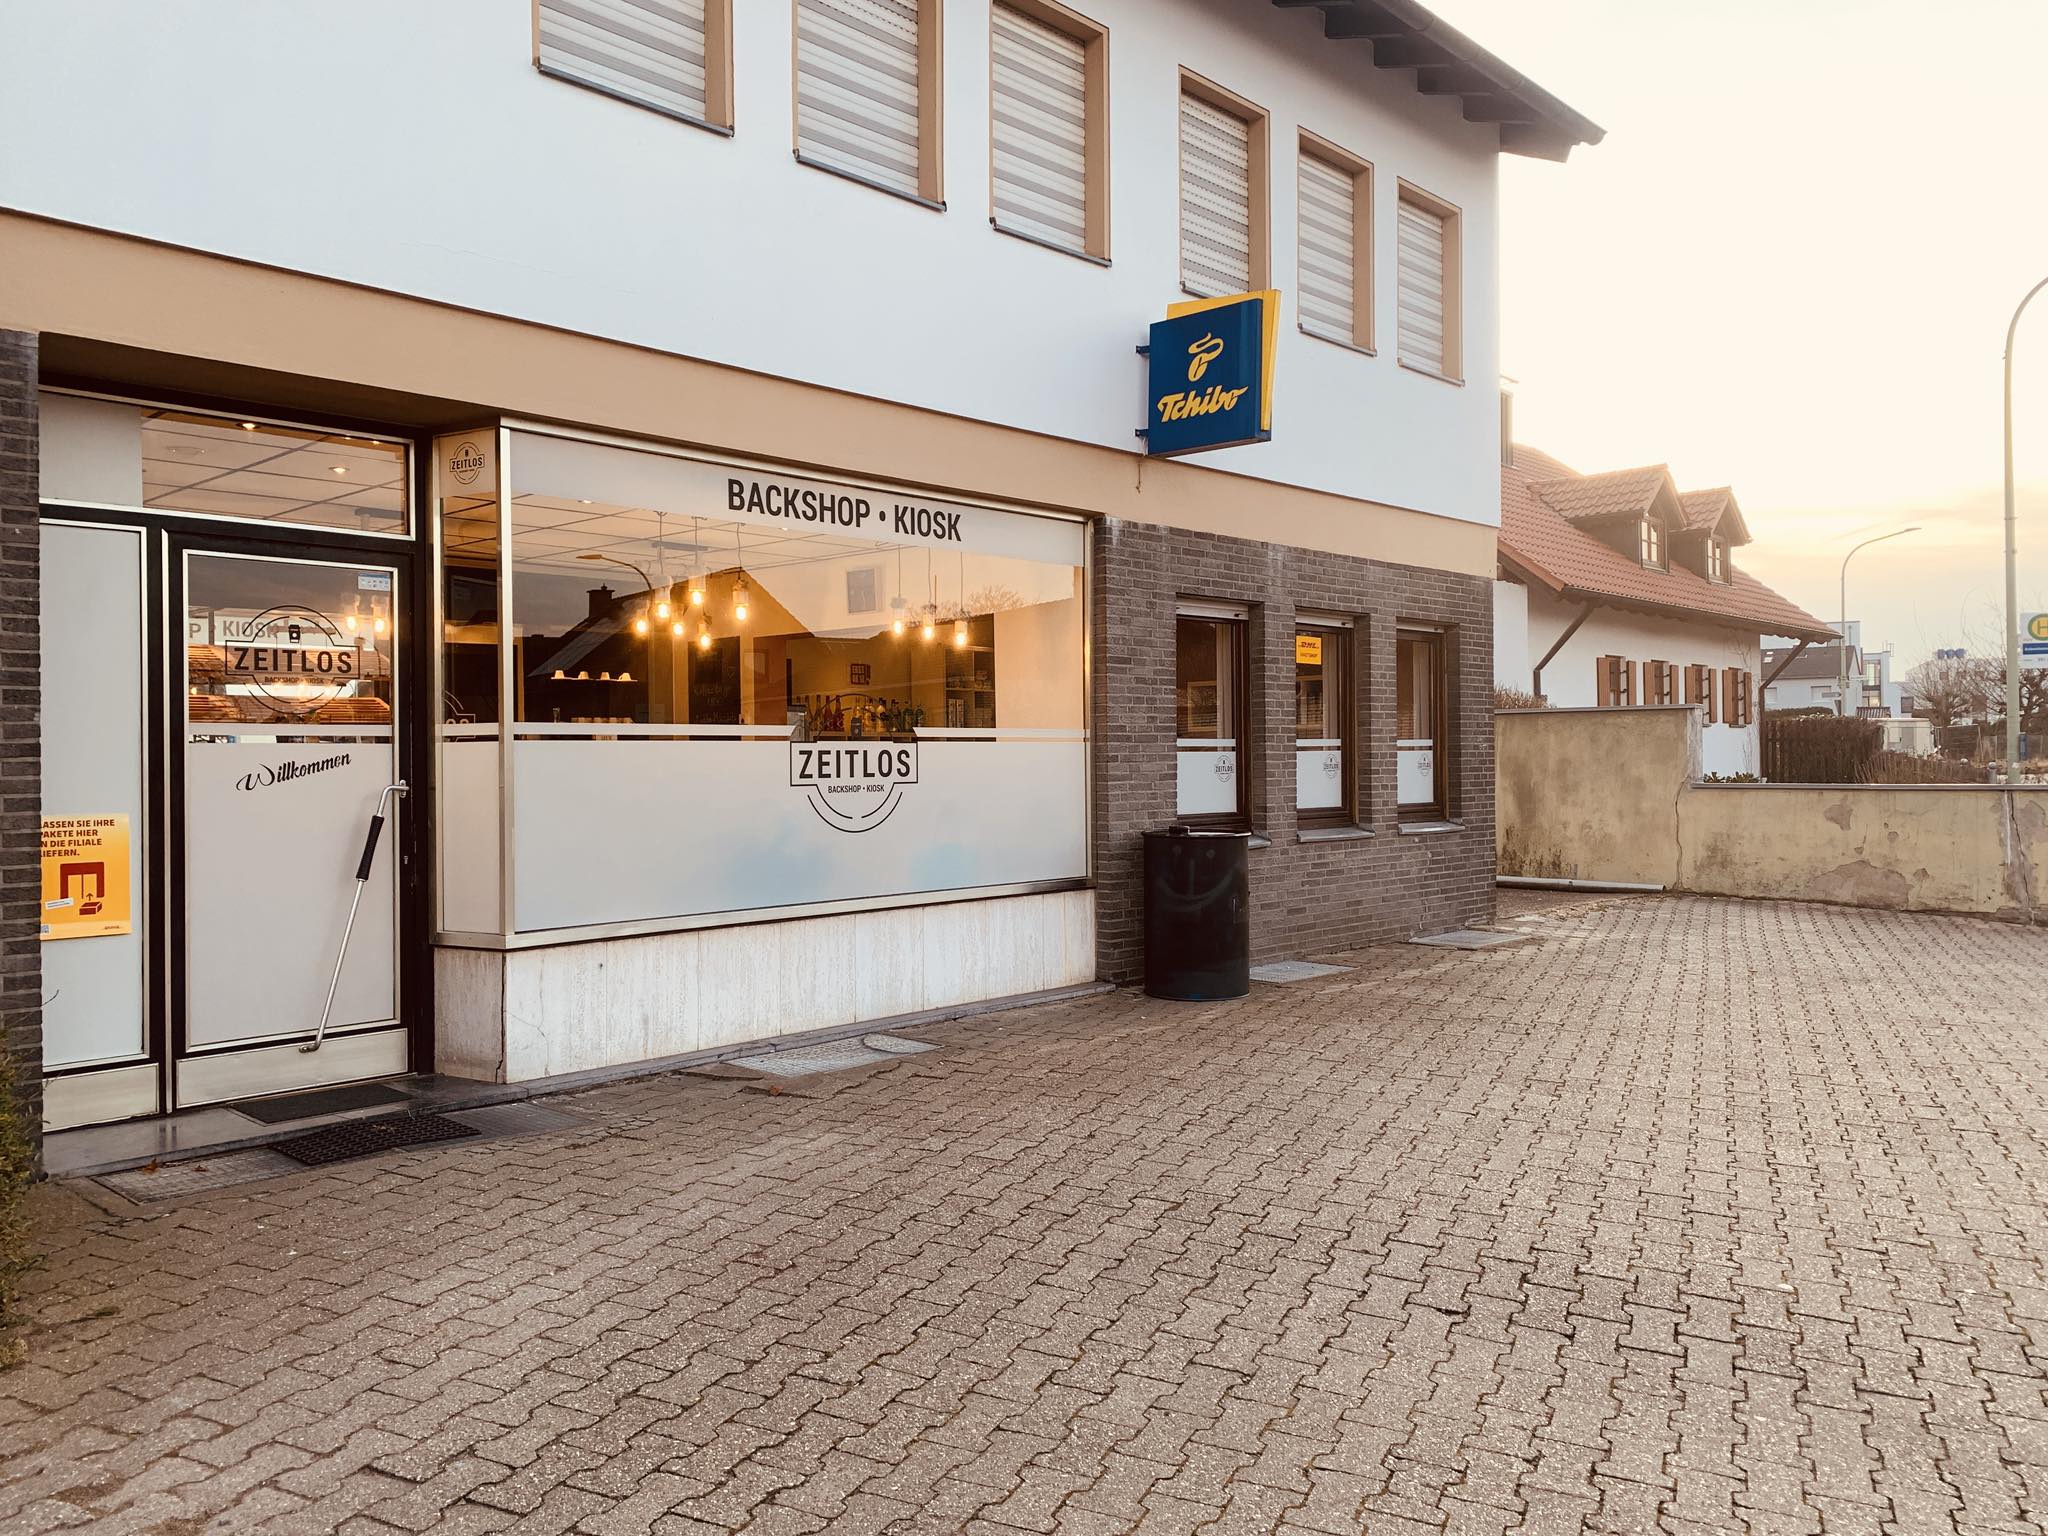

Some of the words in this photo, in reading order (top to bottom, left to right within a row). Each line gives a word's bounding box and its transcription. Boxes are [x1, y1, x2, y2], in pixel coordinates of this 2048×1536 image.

[1157, 385, 1248, 423] Tchibo
[451, 457, 483, 470] ZEITLOS
[727, 478, 871, 528] BACKSHOP
[894, 504, 962, 542] KIOSK
[233, 647, 352, 674] ZEITLOS
[264, 676, 300, 684] BACKSHOP
[798, 749, 911, 779] ZEITLOS
[236, 753, 352, 791] Willkommen
[828, 785, 862, 794] BACKSHOP
[866, 784, 885, 793] KIOSK
[41, 820, 74, 829] ASSEN
[93, 819, 115, 827] IHRE
[76, 829, 98, 837] HIER
[68, 838, 102, 847] FILIALE
[40, 849, 80, 857] IEFERN.
